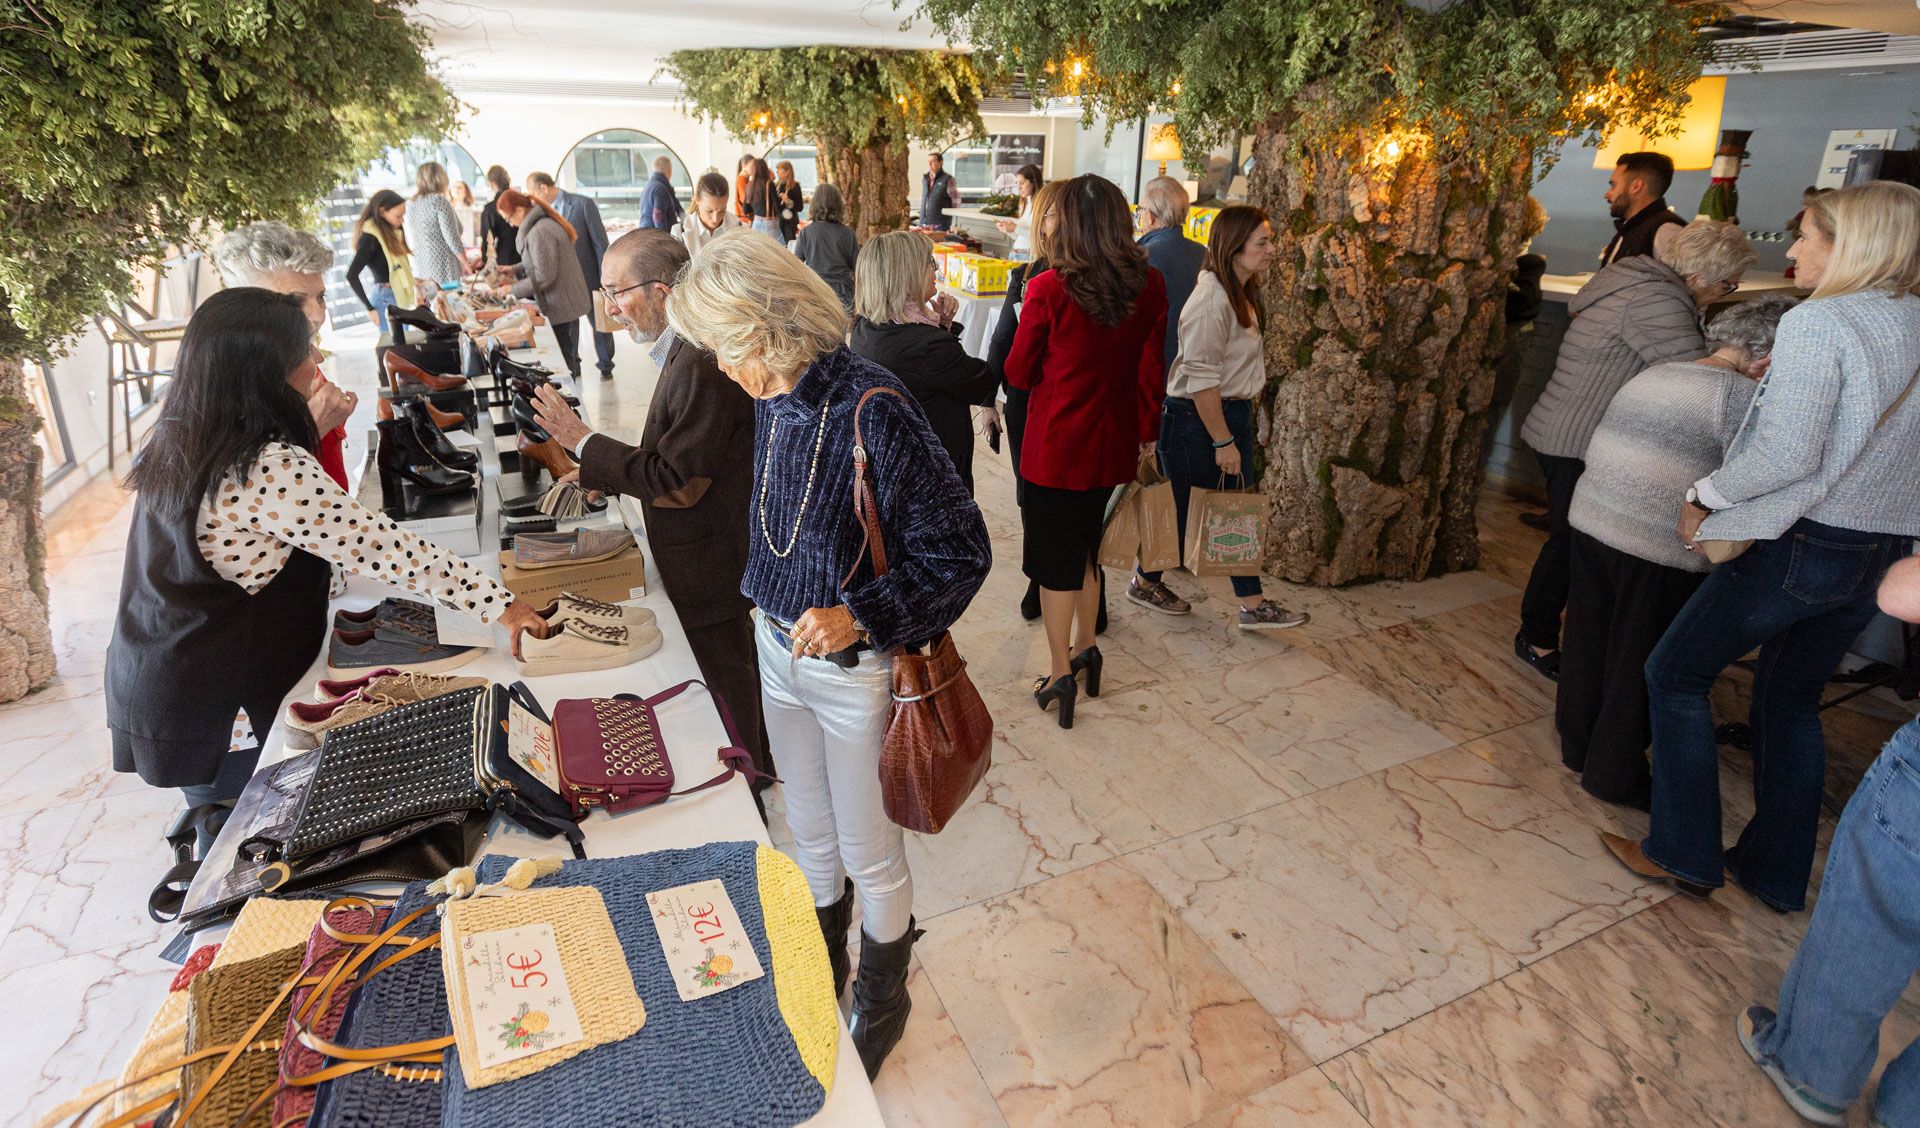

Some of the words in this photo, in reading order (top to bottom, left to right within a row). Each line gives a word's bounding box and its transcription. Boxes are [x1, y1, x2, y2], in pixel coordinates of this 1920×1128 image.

[533, 726, 551, 761] 20€
[687, 901, 725, 944] 12€
[480, 941, 496, 996] Mercadillo
[493, 940, 505, 984] Solidario
[507, 949, 548, 988] 5€
